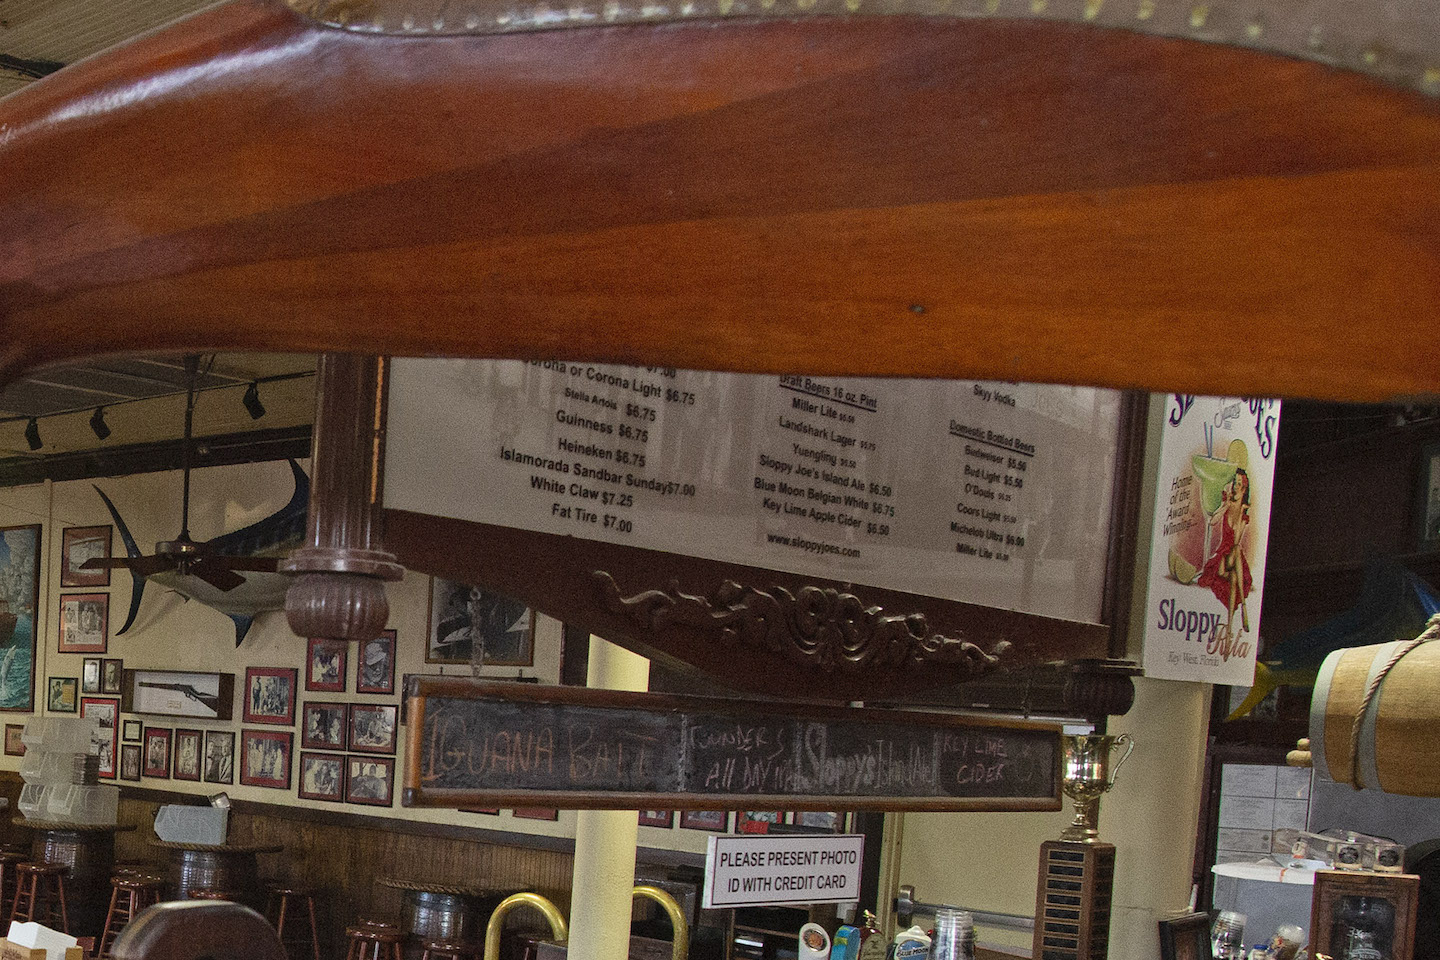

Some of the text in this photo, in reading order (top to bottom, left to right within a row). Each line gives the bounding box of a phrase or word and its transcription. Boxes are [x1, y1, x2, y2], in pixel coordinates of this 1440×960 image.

[570, 366, 583, 378] or
[586, 367, 630, 389] Corona
[632, 378, 663, 399] Light
[665, 388, 697, 407] $6.75
[804, 378, 831, 396] Beers
[832, 386, 844, 399] 16
[860, 393, 878, 409] Pint
[993, 391, 1016, 408] Vodka
[564, 387, 657, 422] Stella Artois $6.75
[791, 397, 819, 414] Miller
[820, 404, 838, 420] Lite
[556, 409, 649, 444] Guinness $6.75
[779, 415, 829, 441] Landshark
[830, 430, 857, 448] Lager
[949, 419, 1036, 455] Domestic Bottled Beers
[500, 446, 570, 474] Islamorada
[573, 463, 623, 485] Sandbar
[558, 437, 647, 468] Heineken $6.75
[793, 443, 838, 467] Yuengling
[964, 444, 1004, 465] Budweiser
[760, 454, 793, 475] Sloppy
[795, 463, 820, 480] Joe's
[822, 470, 850, 488] Island
[851, 478, 866, 492] Ale
[964, 464, 981, 478] Bud
[530, 475, 634, 508] White Claw $7.25
[754, 477, 777, 493] Blue
[778, 482, 805, 498] Moon
[807, 488, 842, 505] Belgian
[844, 495, 870, 511] White
[551, 503, 633, 533] Fat Tire $7.00
[763, 497, 782, 514] Key
[784, 502, 808, 517] Lime
[809, 507, 836, 524] Apple
[837, 514, 863, 529] Cider
[1157, 598, 1221, 643] Sloppy
[422, 704, 659, 784] IGUANA BAIT
[720, 850, 857, 868] PLEASE PRESENT PHOTO
[728, 874, 847, 893] ID WITH CREDIT CARD
